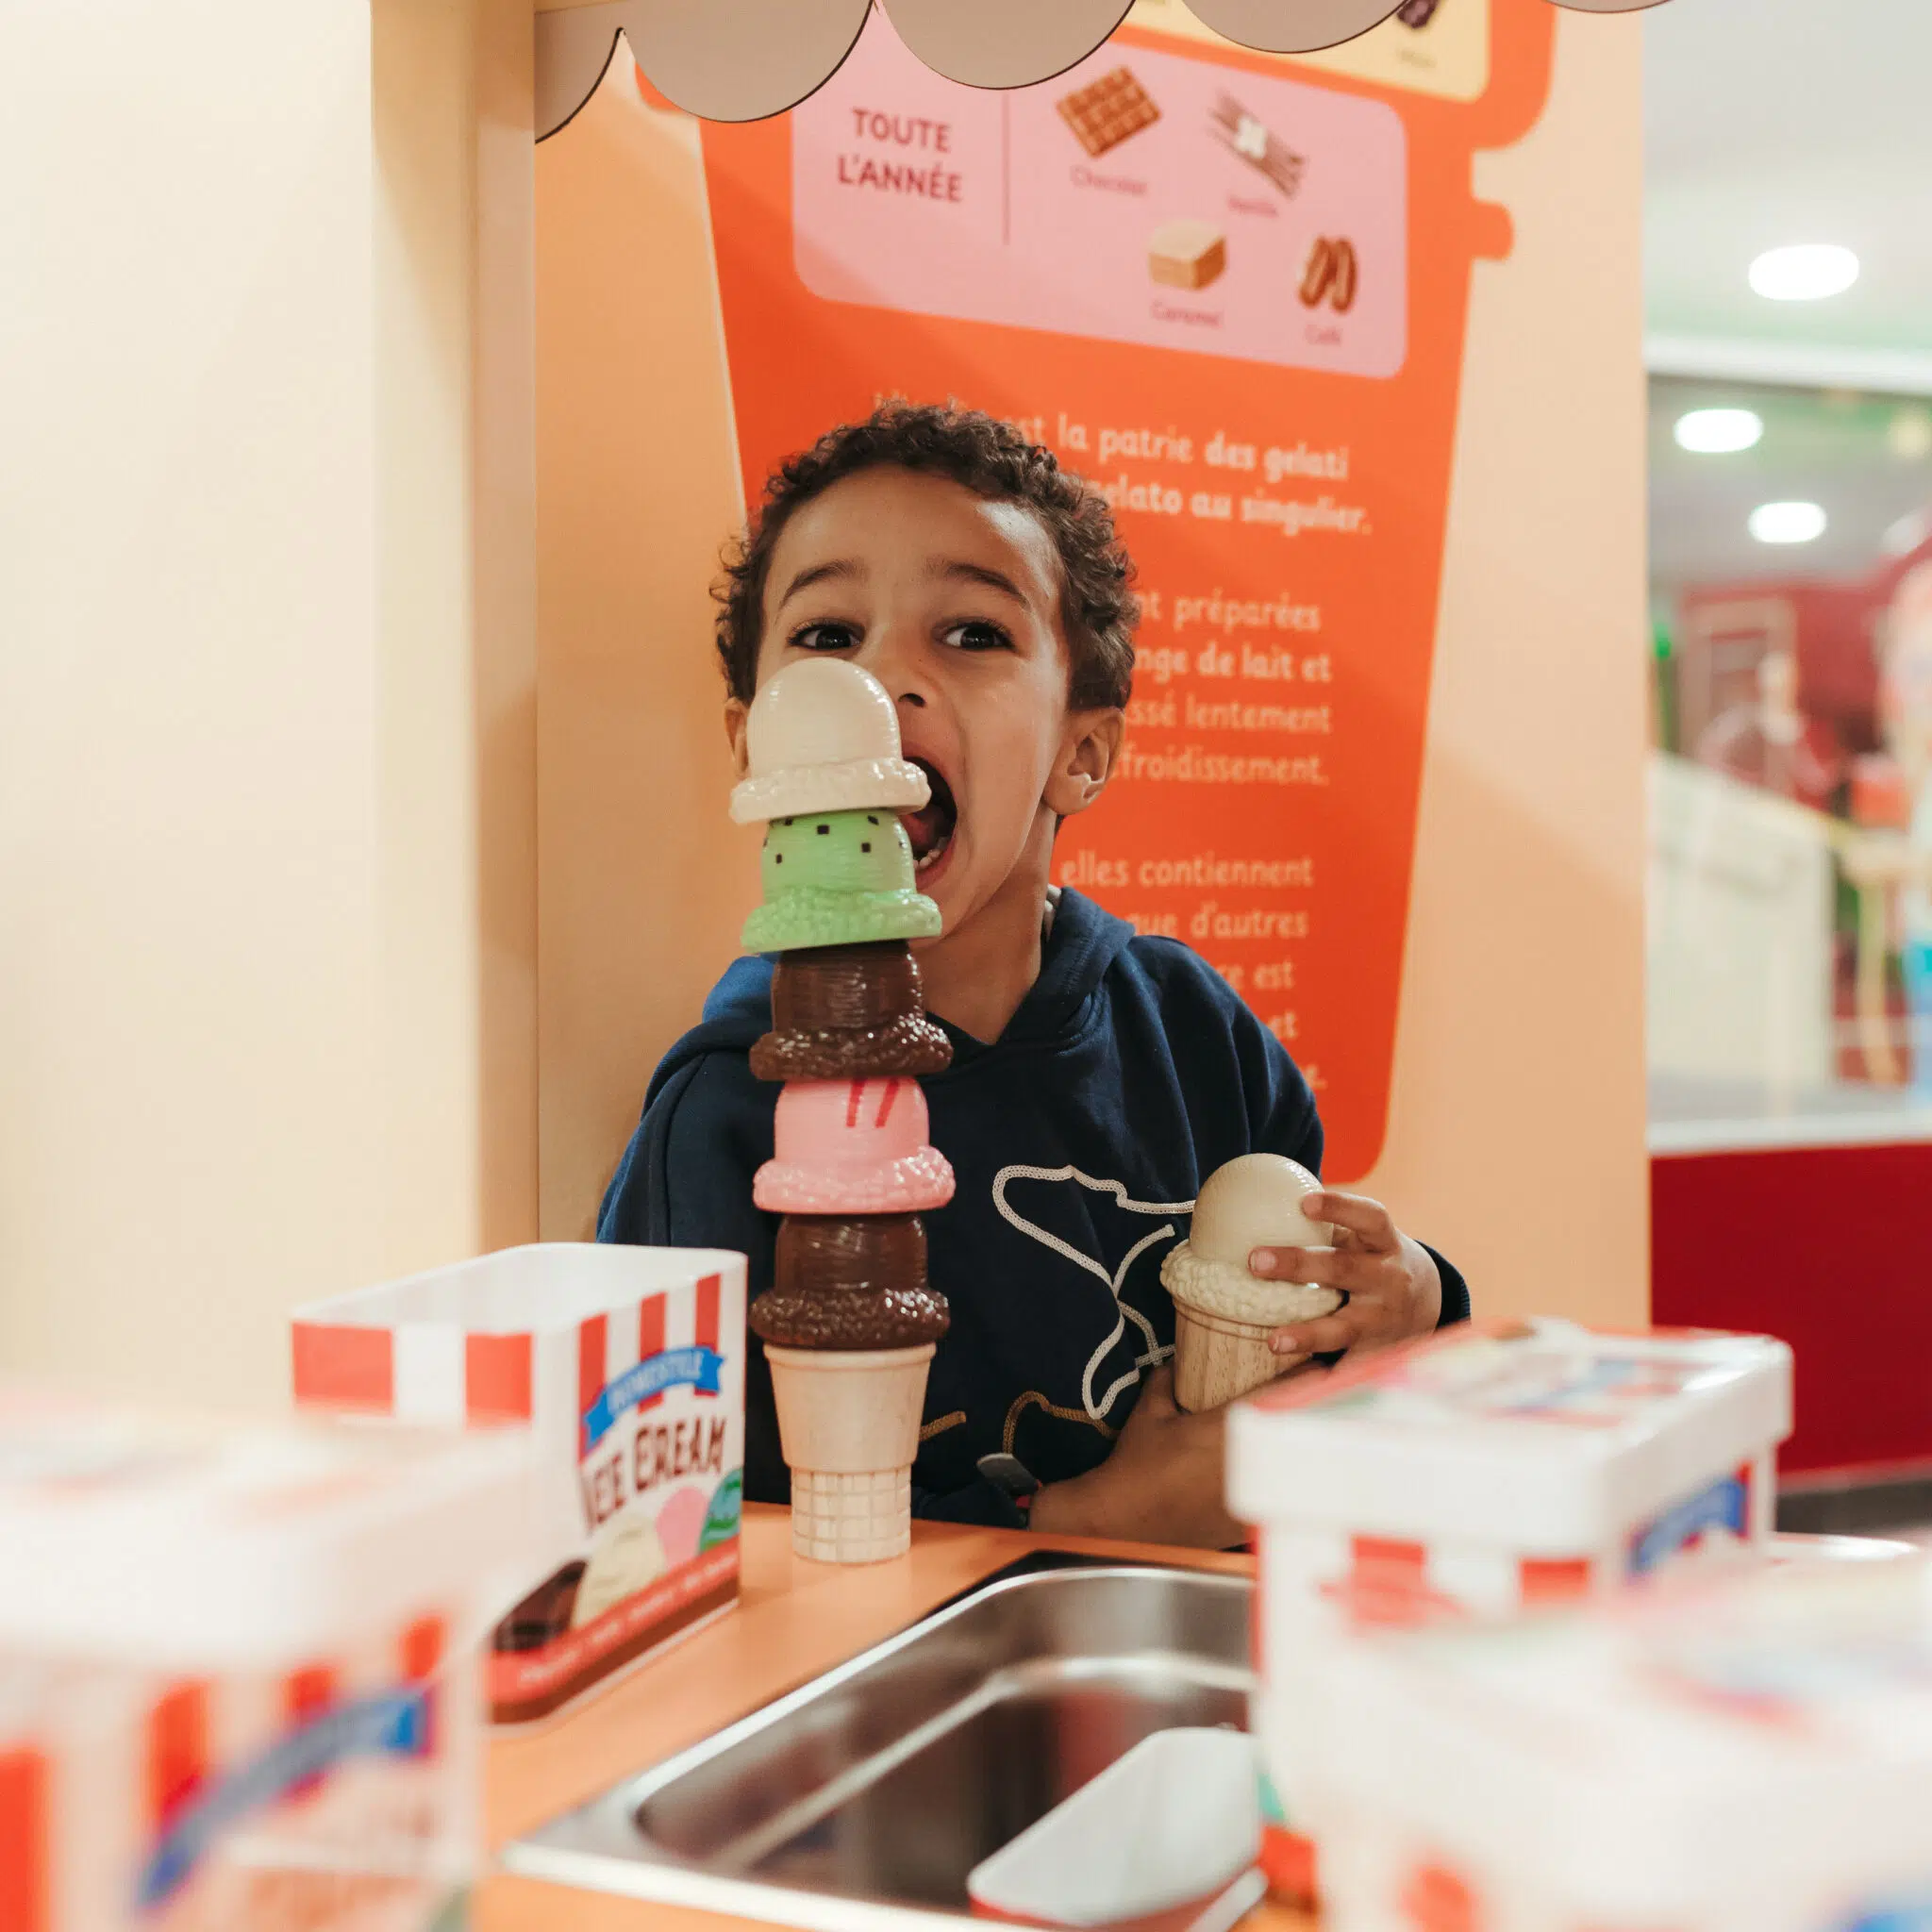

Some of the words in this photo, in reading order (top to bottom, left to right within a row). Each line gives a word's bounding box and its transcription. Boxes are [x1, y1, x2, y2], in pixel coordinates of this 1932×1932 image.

[852, 106, 951, 154] TOUTE
[1058, 412, 1090, 453] la
[1098, 425, 1194, 465] patrie
[1206, 430, 1257, 471] des
[1265, 440, 1350, 484] gelati
[1191, 491, 1232, 521] au
[1174, 587, 1322, 633] préparées
[1197, 641, 1234, 677] de
[1241, 641, 1293, 681] lait
[1301, 653, 1333, 682] et
[1184, 692, 1333, 735] lentement
[1115, 741, 1329, 786] froidissement.
[1058, 849, 1130, 888] elles
[1138, 851, 1315, 889] contiennent
[1253, 958, 1294, 990] est
[634, 1417, 726, 1493] CREAM
